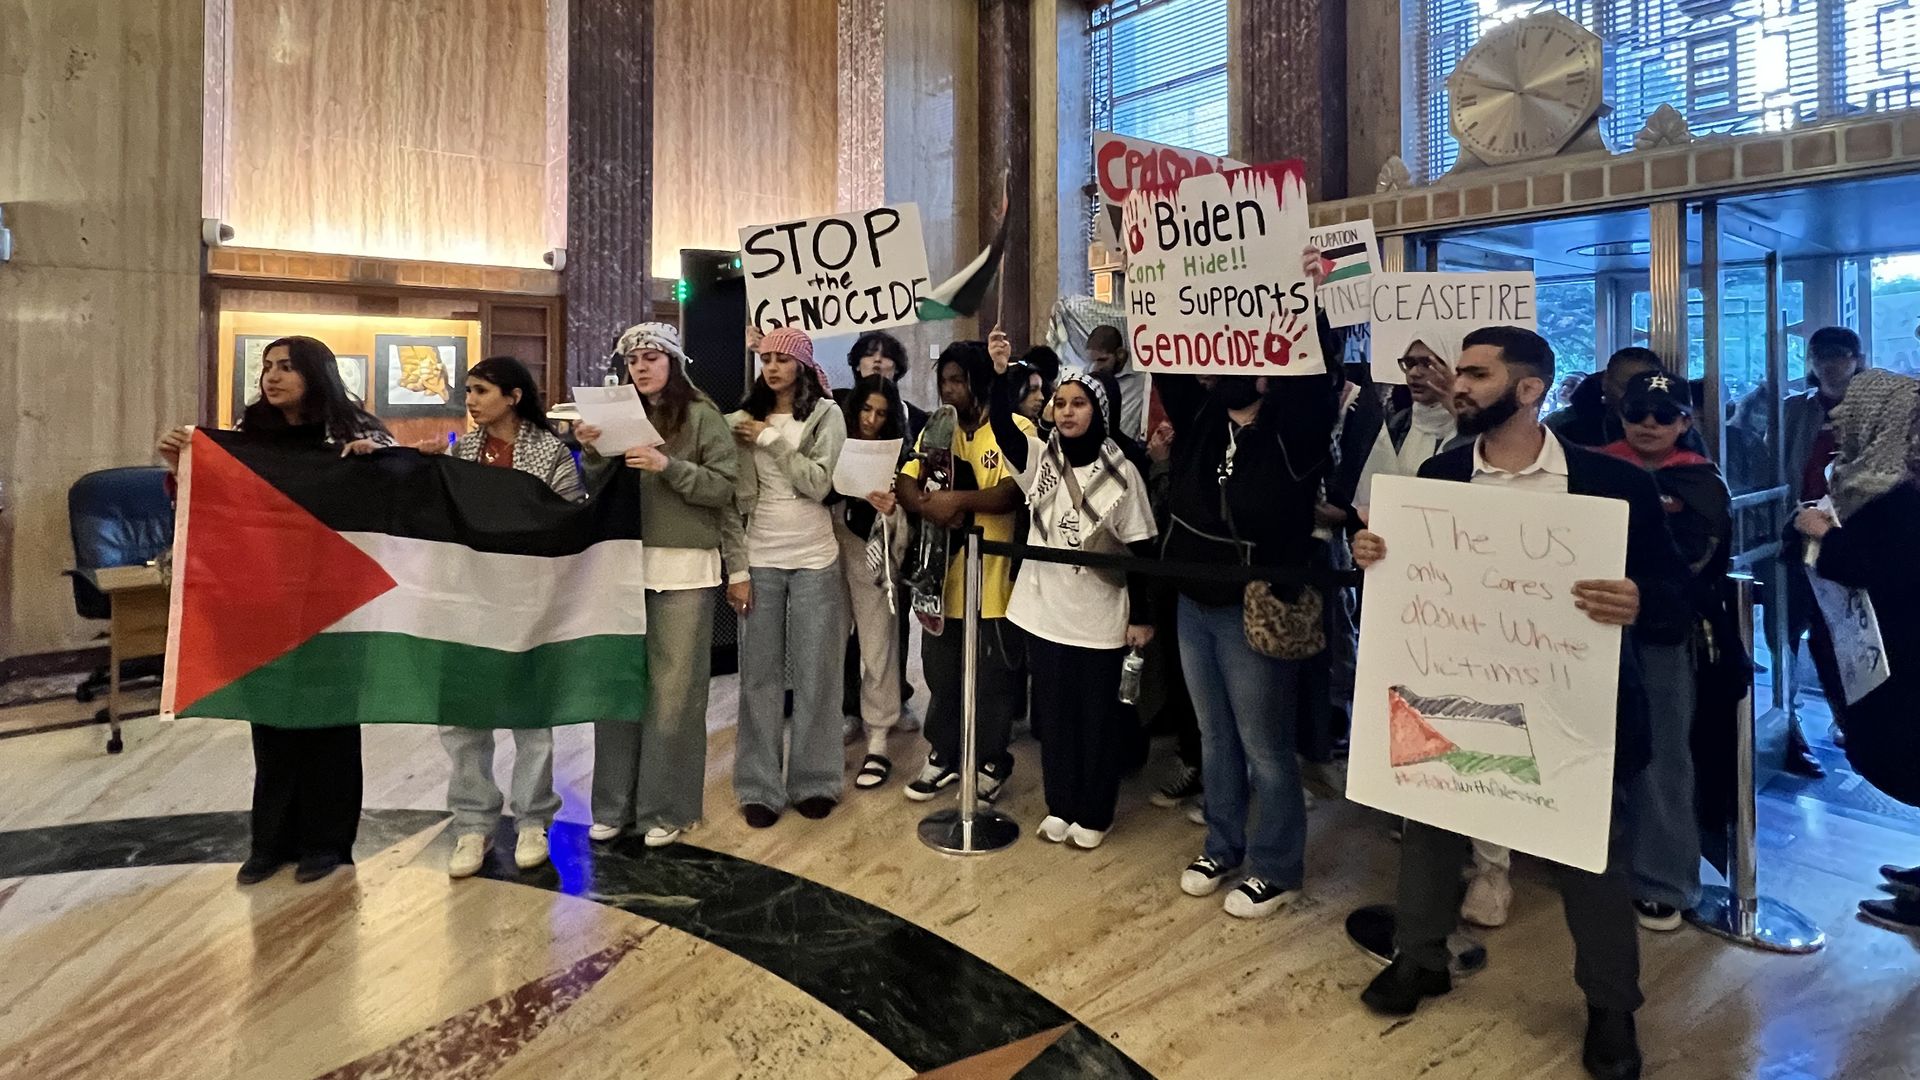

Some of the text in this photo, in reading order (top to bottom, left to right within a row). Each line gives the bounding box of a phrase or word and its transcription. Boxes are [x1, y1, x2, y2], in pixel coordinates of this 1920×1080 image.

[745, 208, 900, 279] STOP
[1155, 200, 1266, 251] Biden
[807, 271, 853, 292] the
[1184, 246, 1248, 278] Hide!!
[755, 278, 928, 336] GENOCIDE
[1131, 289, 1157, 316] He
[1373, 283, 1532, 323] CEASEFIRE
[1401, 505, 1576, 568] The US
[1407, 561, 1453, 596] only
[1401, 594, 1590, 661] about White
